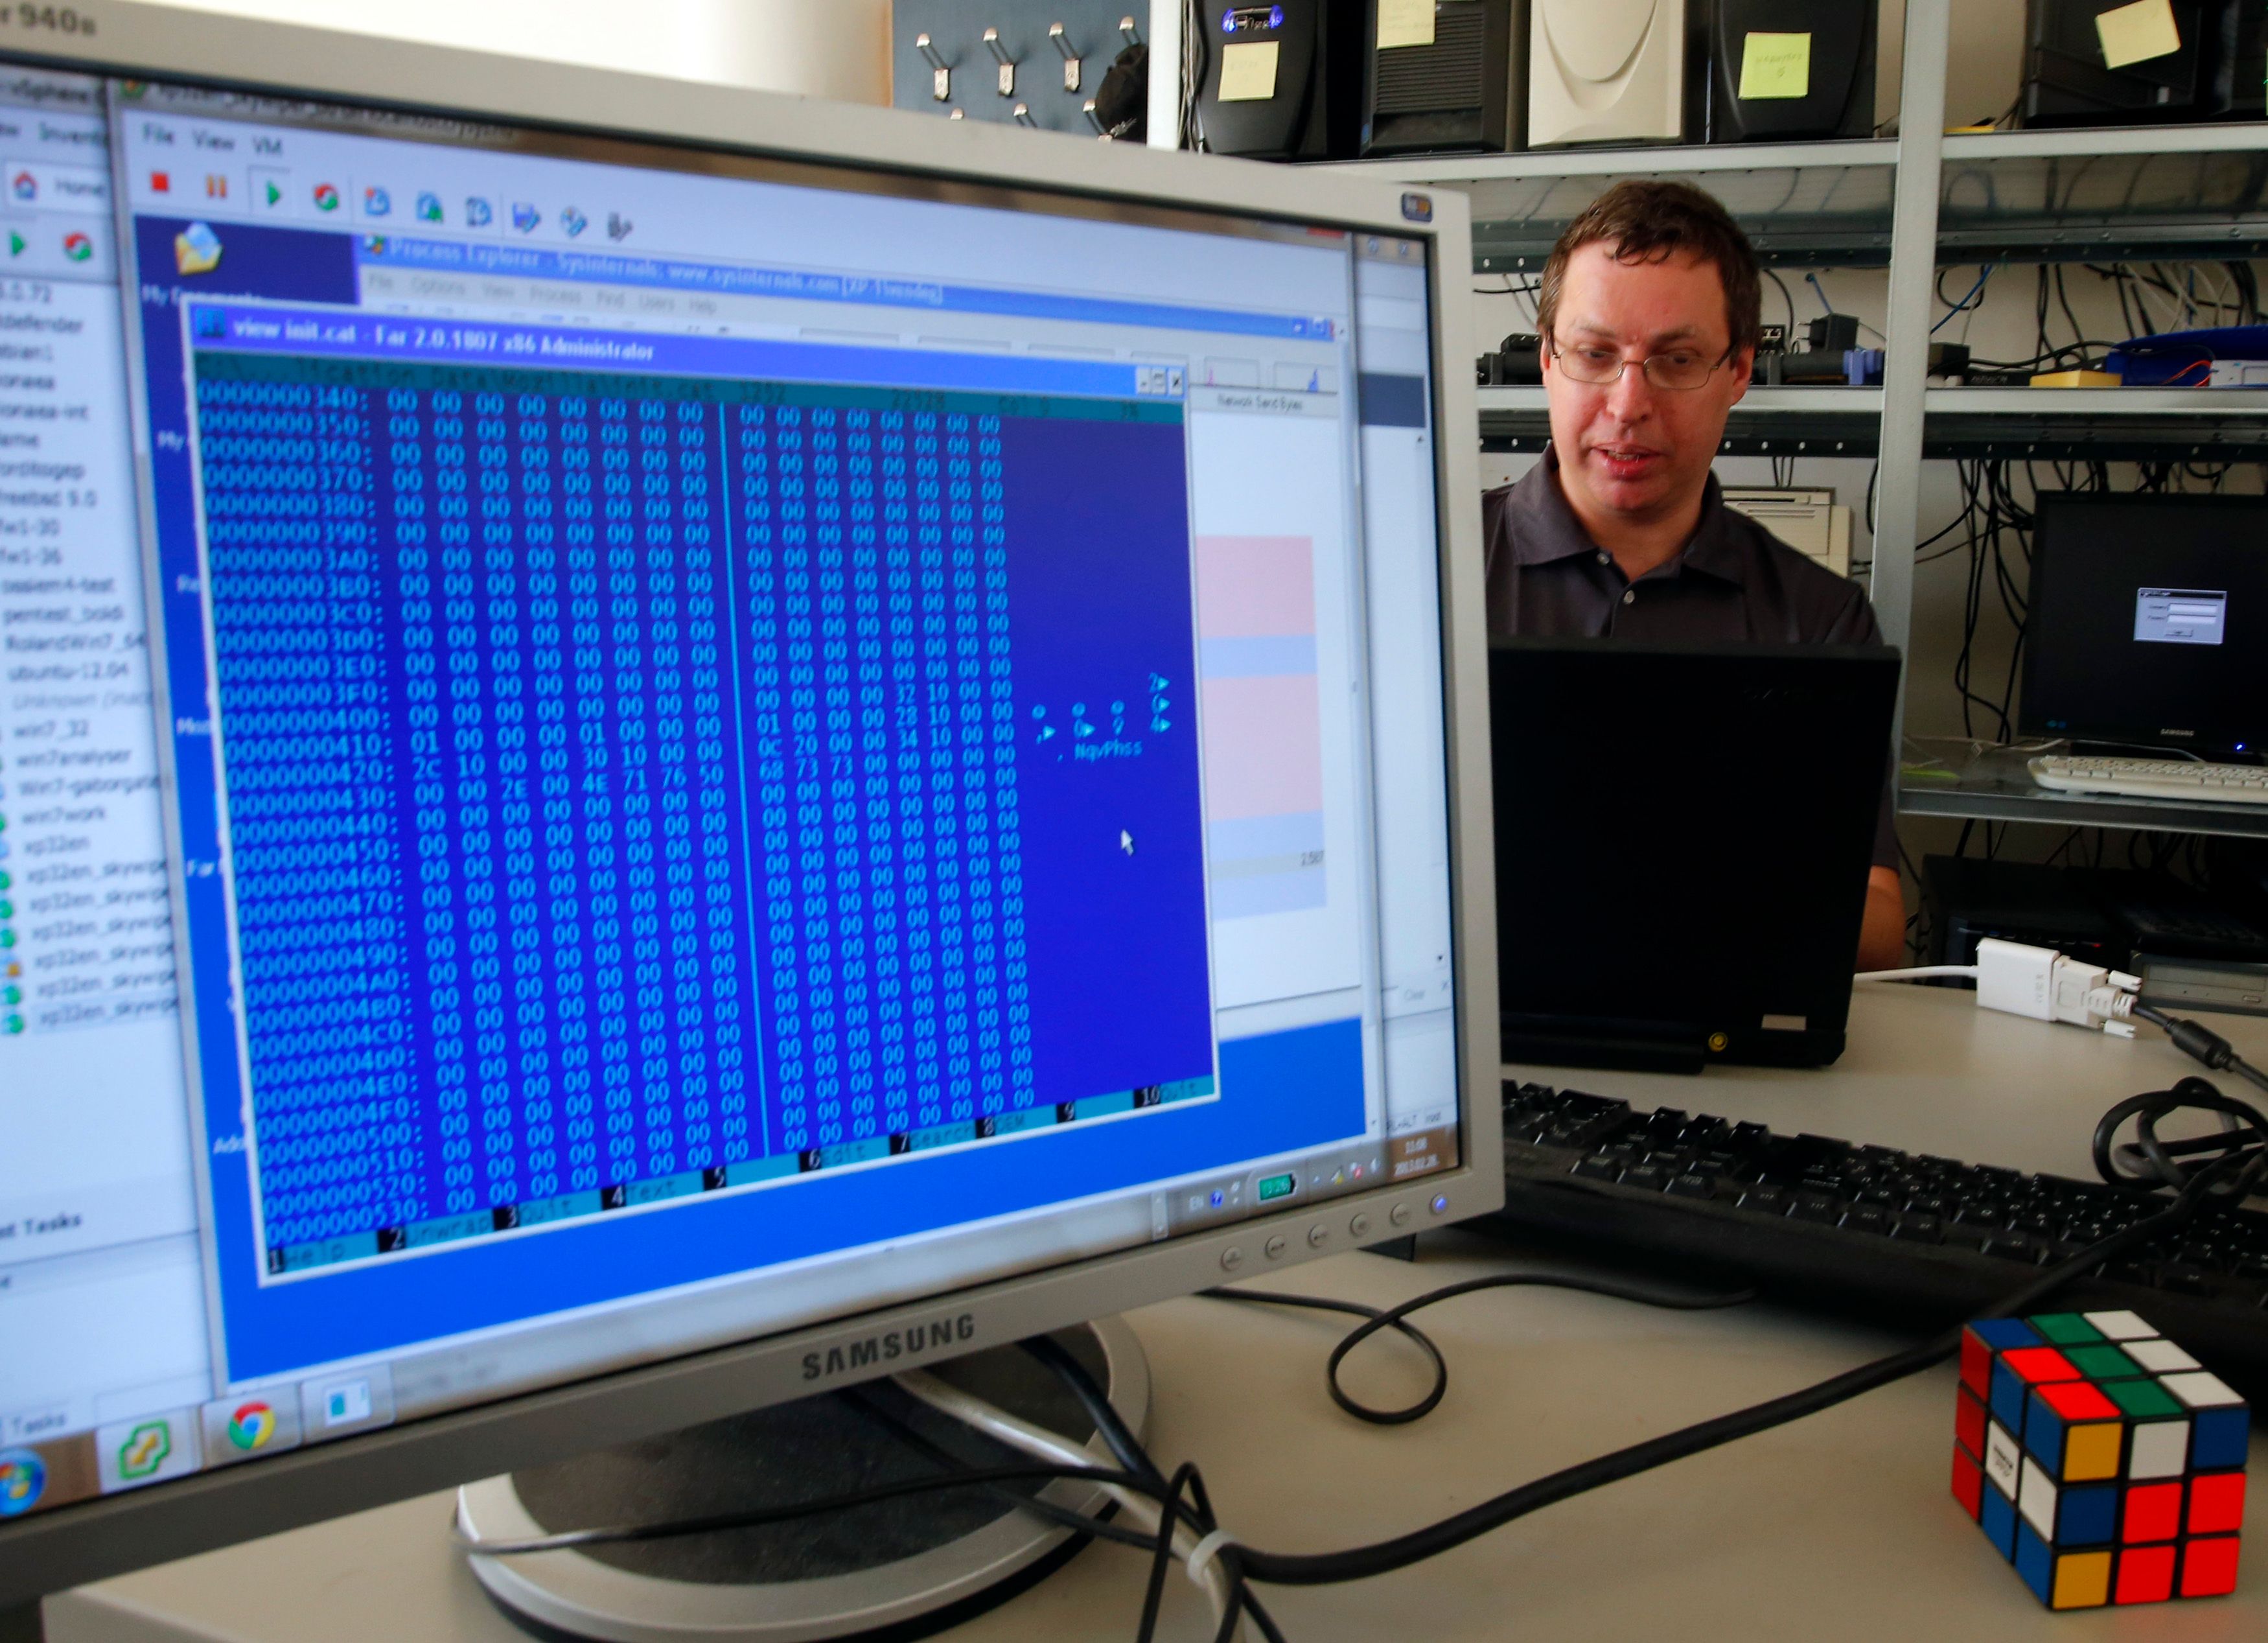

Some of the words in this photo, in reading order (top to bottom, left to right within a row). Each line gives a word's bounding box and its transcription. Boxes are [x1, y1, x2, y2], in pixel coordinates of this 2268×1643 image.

[143, 123, 174, 145] File
[192, 130, 235, 151] View
[253, 137, 283, 155] VM
[233, 318, 280, 340] view
[375, 325, 408, 347] Far
[540, 334, 655, 362] Administrator
[212, 576, 385, 599] 00000003B0:
[399, 575, 430, 597] 00
[443, 575, 474, 596] 00
[487, 574, 516, 596] 00
[528, 574, 557, 595] 00
[570, 574, 597, 594] 00
[609, 574, 637, 594] 00
[649, 573, 675, 594] 00
[687, 573, 713, 593] 00
[748, 572, 774, 592] 00
[785, 572, 809, 592] 00
[820, 572, 844, 591] 00
[854, 572, 878, 590] 00
[888, 572, 911, 590] 00
[921, 571, 943, 590] 00
[953, 571, 975, 589] 00
[985, 571, 1007, 589] 00
[227, 759, 398, 791] 0000000420:
[498, 752, 527, 774] 00
[540, 749, 568, 771] 00
[659, 743, 686, 764] 00
[697, 740, 723, 762] 00
[829, 733, 853, 753] 00
[863, 731, 886, 751] 00
[961, 725, 983, 745] 00
[993, 724, 1014, 743] 00
[229, 785, 400, 819] 0000000430:
[414, 782, 445, 806] 00
[457, 780, 487, 802] 00
[542, 774, 570, 797] 00
[864, 754, 888, 774] 00
[897, 752, 921, 771] 00
[931, 749, 953, 769] 00
[962, 747, 984, 767] 00
[994, 745, 1015, 765] 00
[801, 1312, 975, 1382] SAMSUNG
